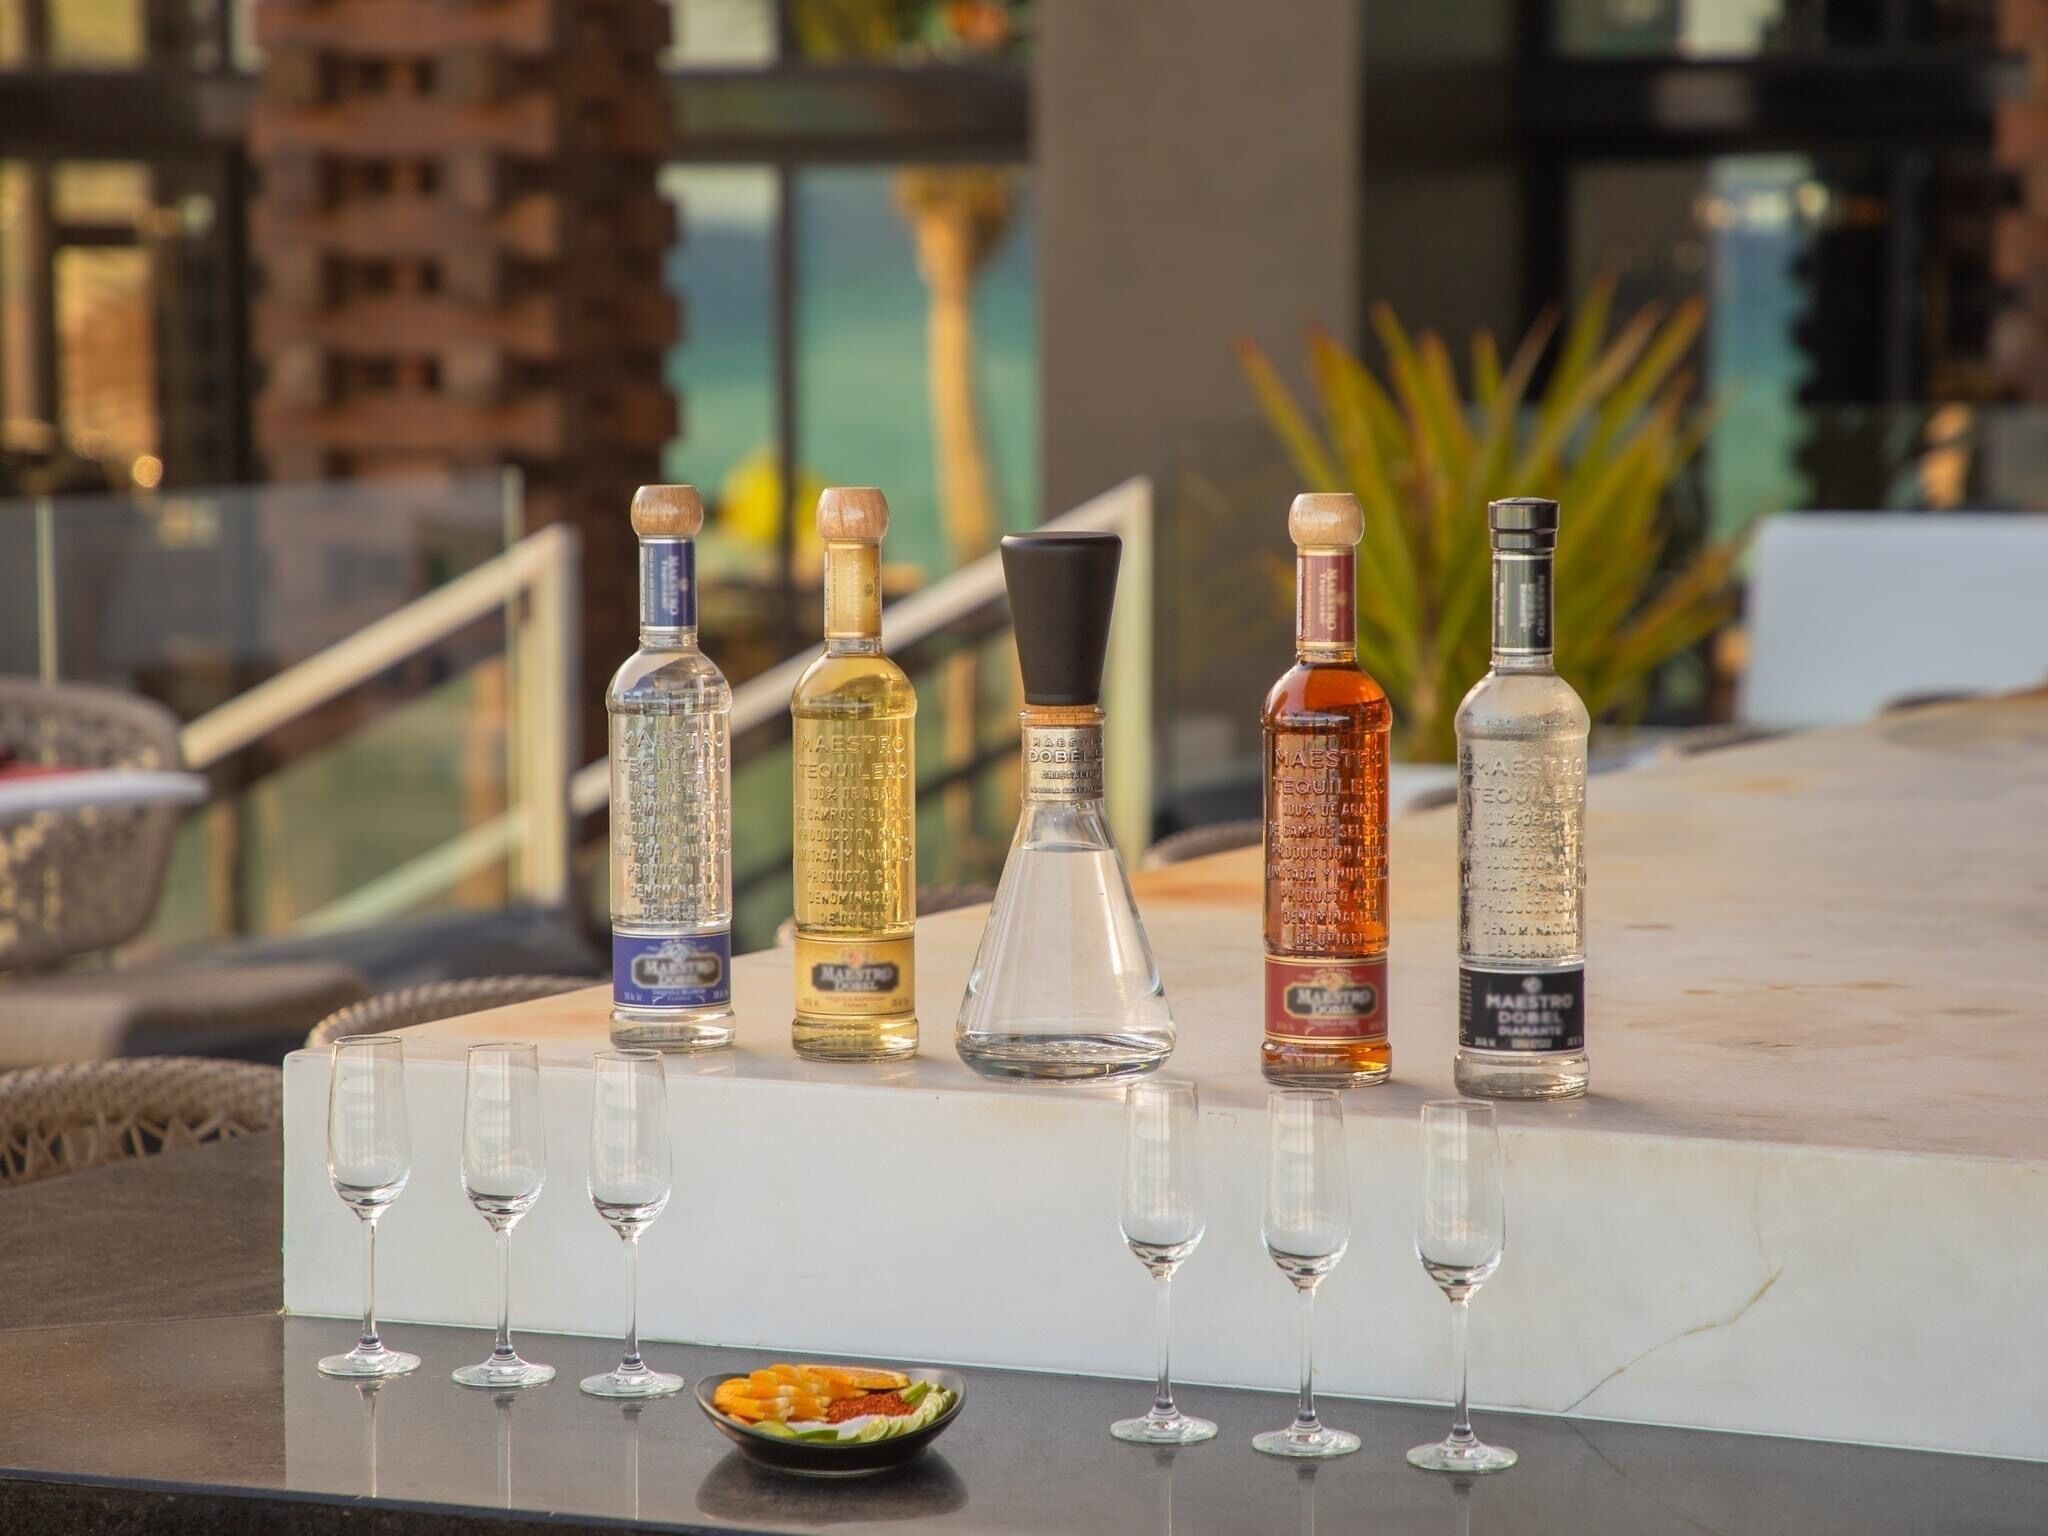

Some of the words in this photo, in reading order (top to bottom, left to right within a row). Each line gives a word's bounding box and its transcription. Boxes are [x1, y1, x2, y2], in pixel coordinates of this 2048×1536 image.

[620, 730, 725, 750] MAESTRO
[801, 735, 906, 755] MAESTRO
[618, 757, 727, 776] TEQUILERO
[1275, 747, 1384, 769] MAESTRO
[1473, 757, 1584, 778] MAESTRO
[800, 761, 908, 780] TEQUILERO
[1272, 775, 1385, 796] TEQUILERO
[820, 965, 894, 981] MAESTRO
[1296, 988, 1372, 1005] MAESTRO
[1485, 994, 1574, 1010] MAESTRO
[1497, 1011, 1564, 1025] DOBEL
[1497, 1025, 1563, 1037] DIAMANTE
